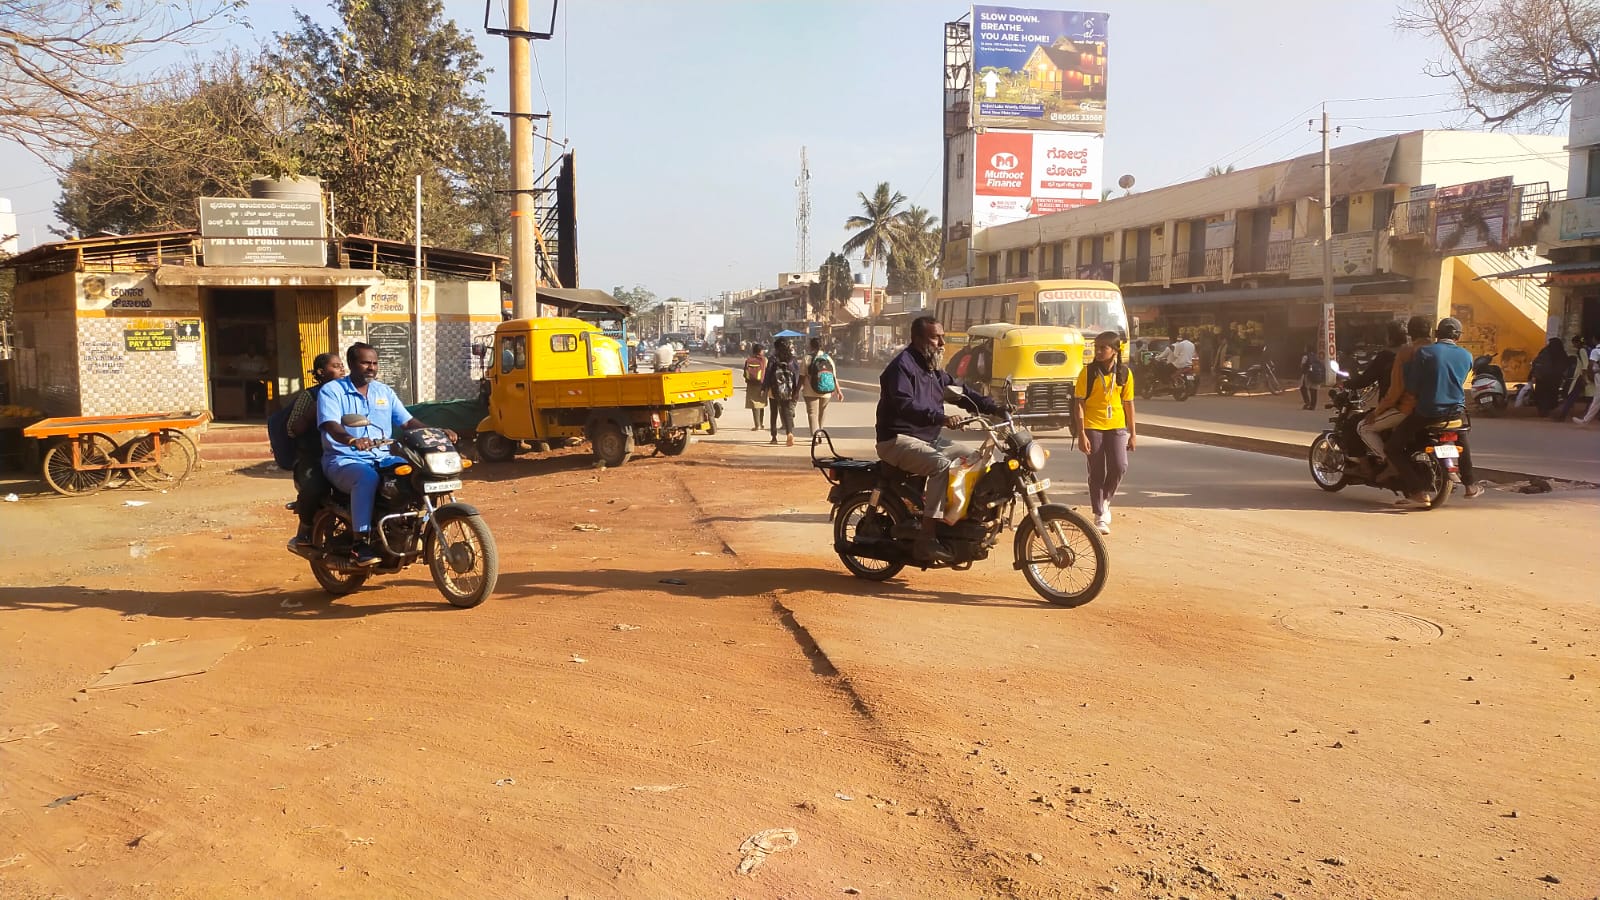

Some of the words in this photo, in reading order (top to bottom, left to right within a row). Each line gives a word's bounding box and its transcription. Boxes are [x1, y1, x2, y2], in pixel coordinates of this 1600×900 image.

[980, 12, 1007, 21] SLOW
[1009, 14, 1040, 23] DOWN.
[980, 22, 1024, 32] BREATHE.
[980, 32, 999, 41] YOU
[1001, 33, 1019, 42] ARE
[1021, 34, 1050, 43] HOME!
[984, 169, 1024, 180] Muthoot
[1046, 164, 1088, 177] ಲೋನ್
[986, 178, 1022, 188] Finance
[247, 227, 279, 237] DELUXE
[211, 238, 226, 246] PAY
[228, 238, 235, 246] &
[237, 238, 254, 246] USE
[255, 238, 286, 246] PUBLIC
[287, 238, 315, 247] TOILET
[1044, 291, 1118, 299] GURUKULA
